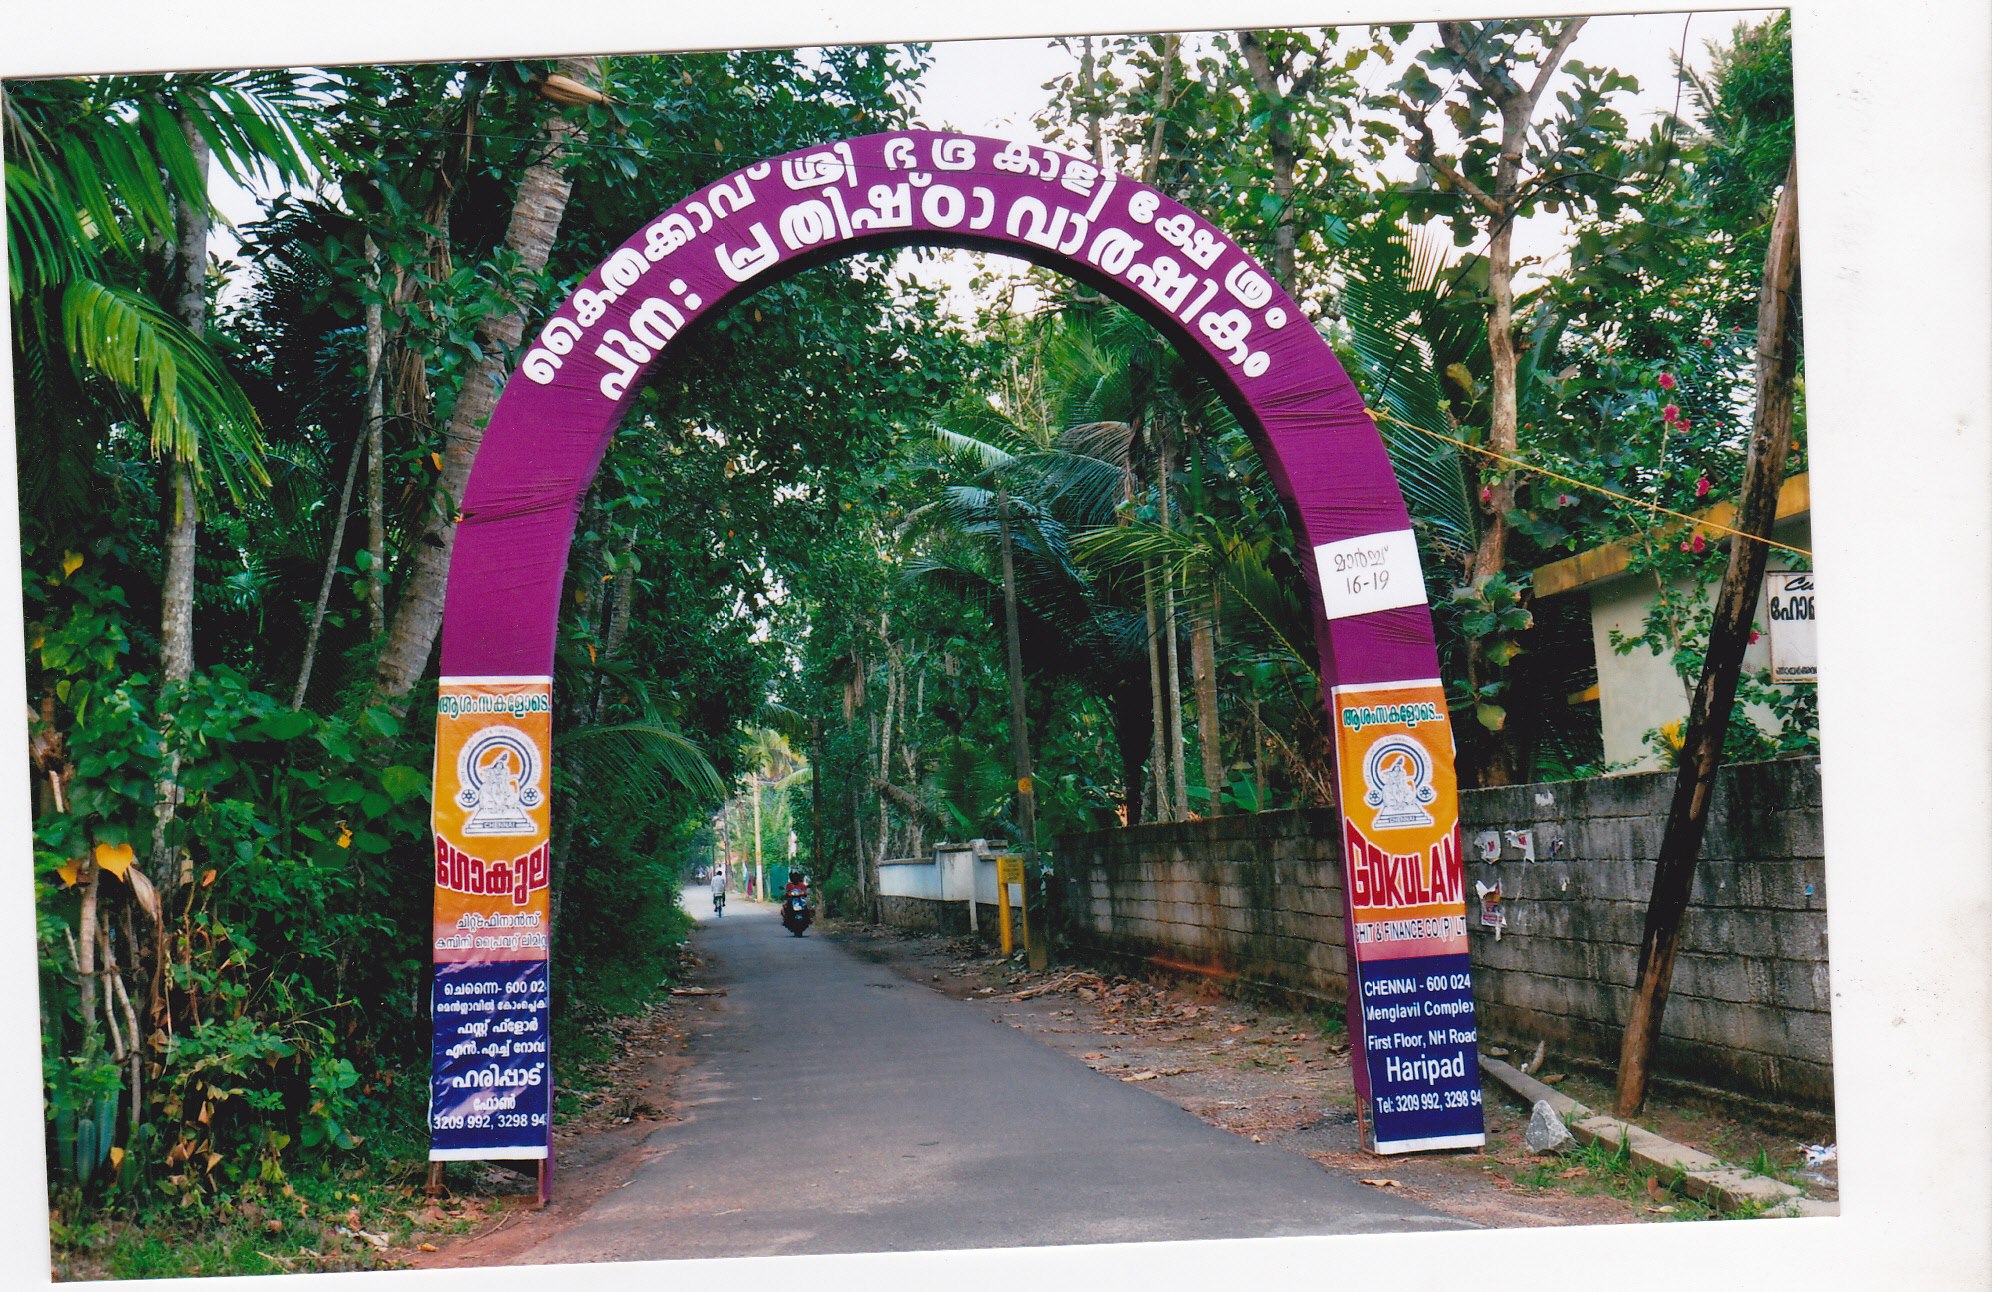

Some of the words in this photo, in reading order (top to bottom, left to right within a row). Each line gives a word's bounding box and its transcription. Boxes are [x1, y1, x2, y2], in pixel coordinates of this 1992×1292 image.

[1128, 190, 1288, 330] ക്ഷേത്രം
[1346, 569, 1390, 595] 16-19
[1345, 817, 1466, 908] GOKULAM
[1376, 923, 1382, 941] &
[1384, 920, 1423, 941] FINANCE
[505, 981, 527, 994] 600
[530, 980, 546, 994] 02
[1364, 977, 1417, 997] CHENNAI
[1426, 975, 1448, 992] 600
[1450, 973, 1472, 990] 024
[1366, 1001, 1420, 1023] Menglavil
[1423, 998, 1476, 1018] Complex
[1367, 1034, 1392, 1052] First
[1393, 1032, 1427, 1049] Floor,
[1428, 1029, 1447, 1046] NH
[1448, 1026, 1478, 1044] Road
[452, 1062, 545, 1088] ഹരിപ്പാട്
[1386, 1051, 1465, 1086] Haripad
[1376, 1096, 1395, 1113] Tel:
[1395, 1093, 1420, 1112] 3209
[1421, 1091, 1444, 1111] 992,
[1444, 1089, 1469, 1108] 3298
[433, 1114, 464, 1130] 3209
[467, 1114, 494, 1131] 992,
[497, 1113, 528, 1128] 3298
[531, 1113, 547, 1127] 94
